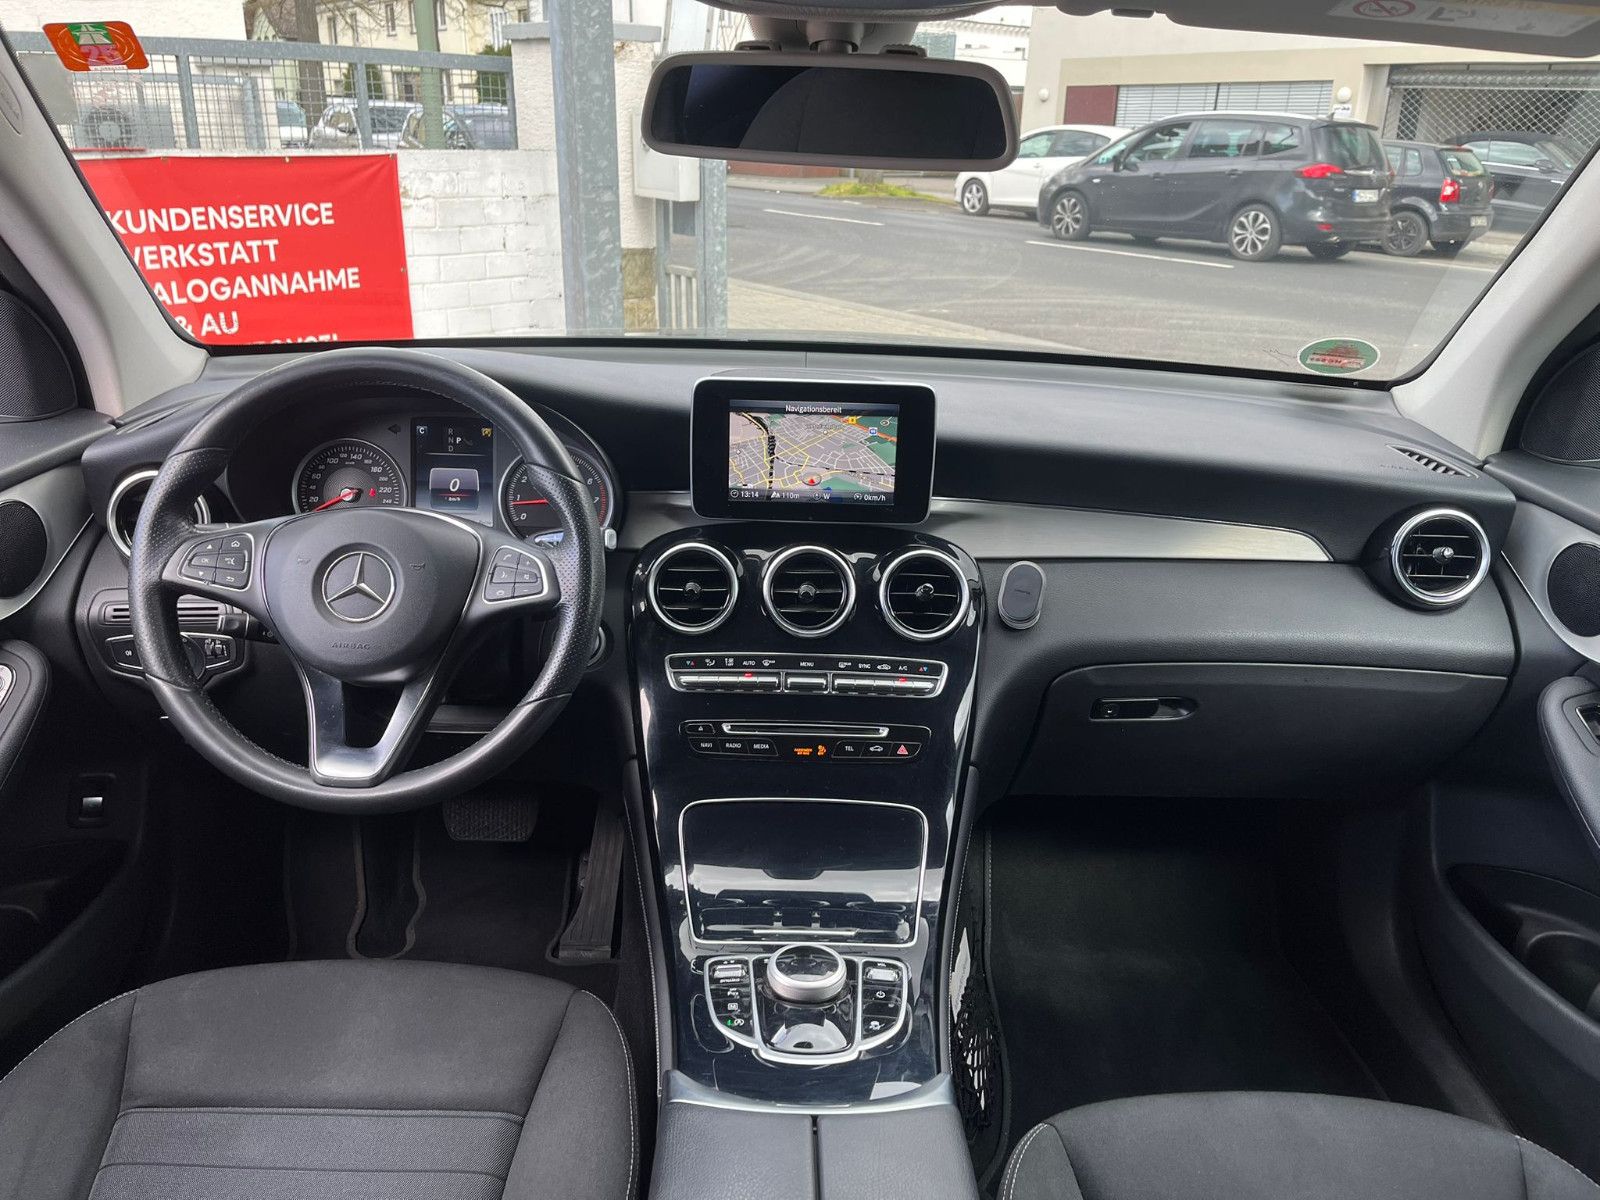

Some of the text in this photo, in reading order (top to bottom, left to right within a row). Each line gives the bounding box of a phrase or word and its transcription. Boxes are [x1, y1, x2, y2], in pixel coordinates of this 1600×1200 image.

[105, 202, 335, 235] KUNDENSERVICE
[201, 311, 239, 337] AU
[785, 404, 843, 414] Navigationsbereit
[449, 478, 460, 492] 0
[740, 490, 759, 498] 13:14
[781, 491, 800, 499] 110m
